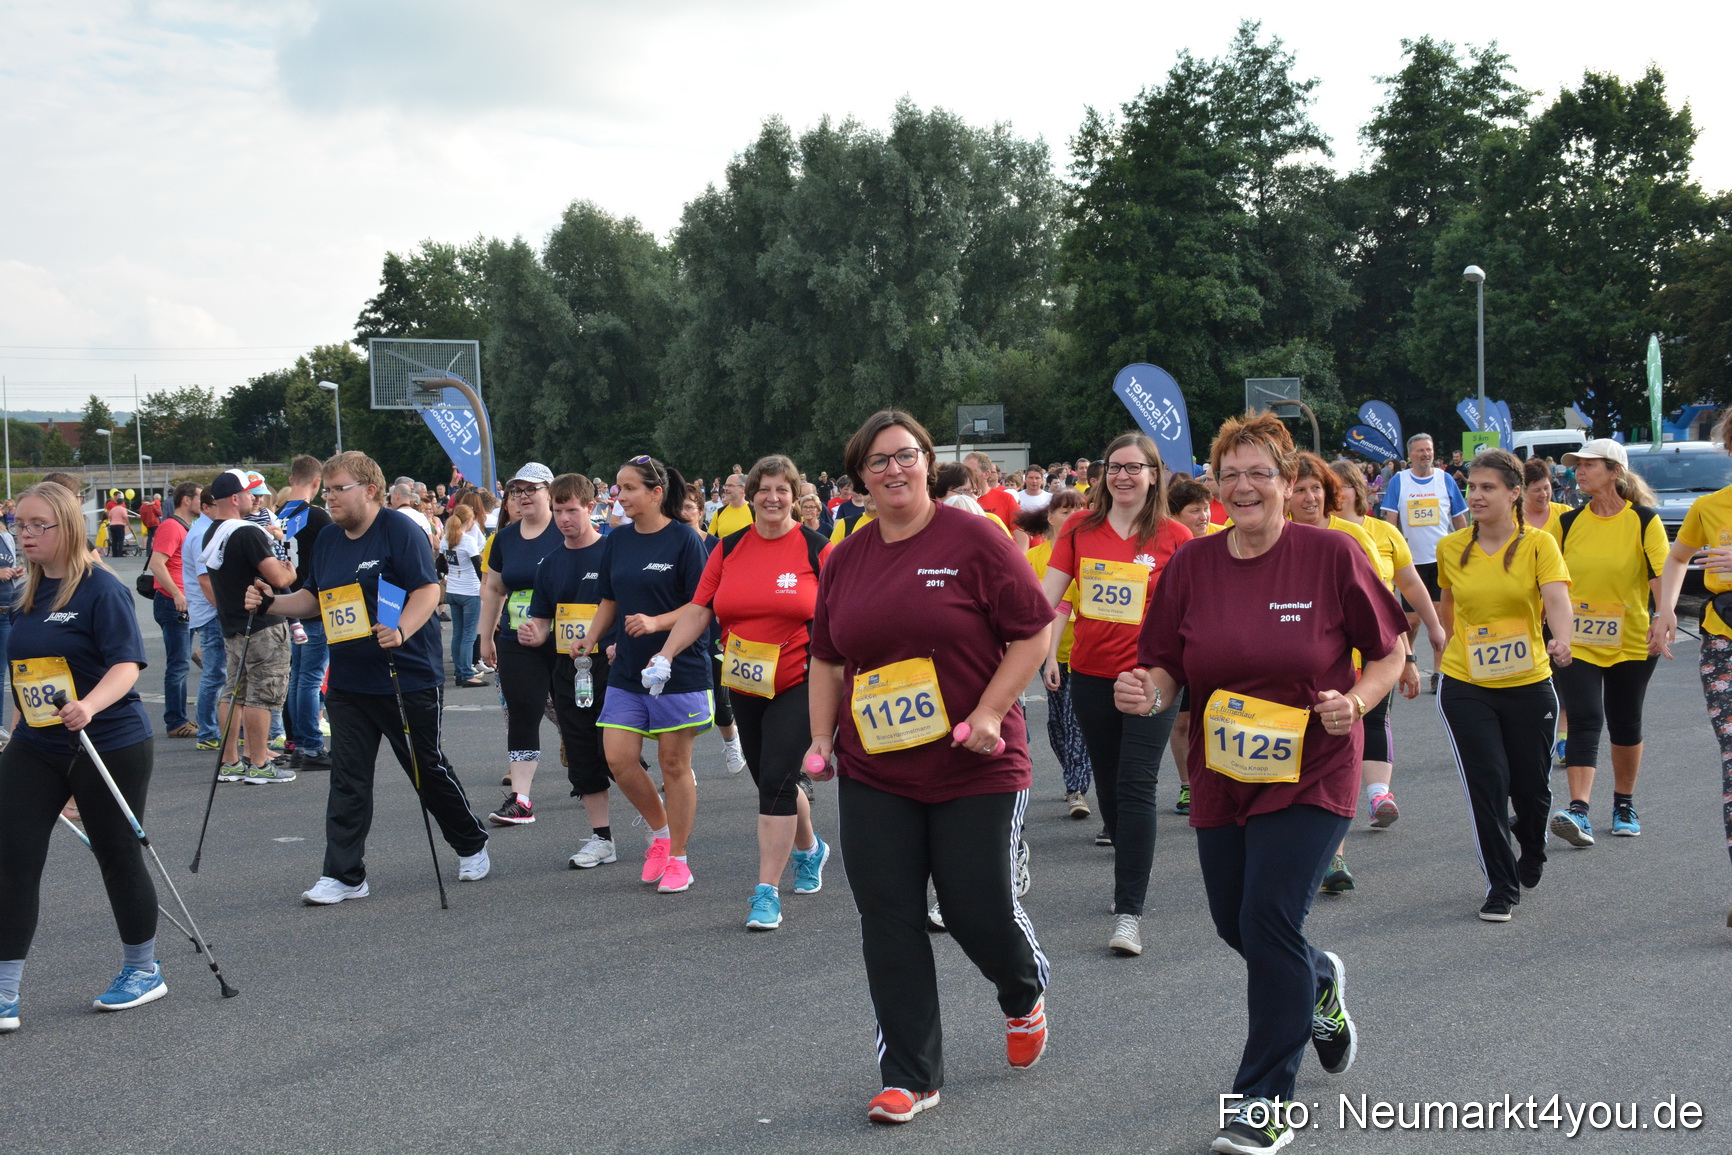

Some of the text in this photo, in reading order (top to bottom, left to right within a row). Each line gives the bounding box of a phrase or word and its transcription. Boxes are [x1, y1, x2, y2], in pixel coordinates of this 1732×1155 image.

[1414, 509, 1433, 519] 554
[917, 568, 959, 576] Firmenlauf
[1092, 584, 1132, 606] 259
[1269, 601, 1313, 610] Firmenlauf
[329, 606, 356, 628] 765
[1573, 618, 1617, 635] 1278
[560, 624, 586, 640] 763
[1473, 641, 1527, 666] 1270
[730, 658, 764, 682] 268
[22, 684, 56, 708] 688
[862, 692, 935, 729] 1126
[1214, 726, 1291, 761] 1125
